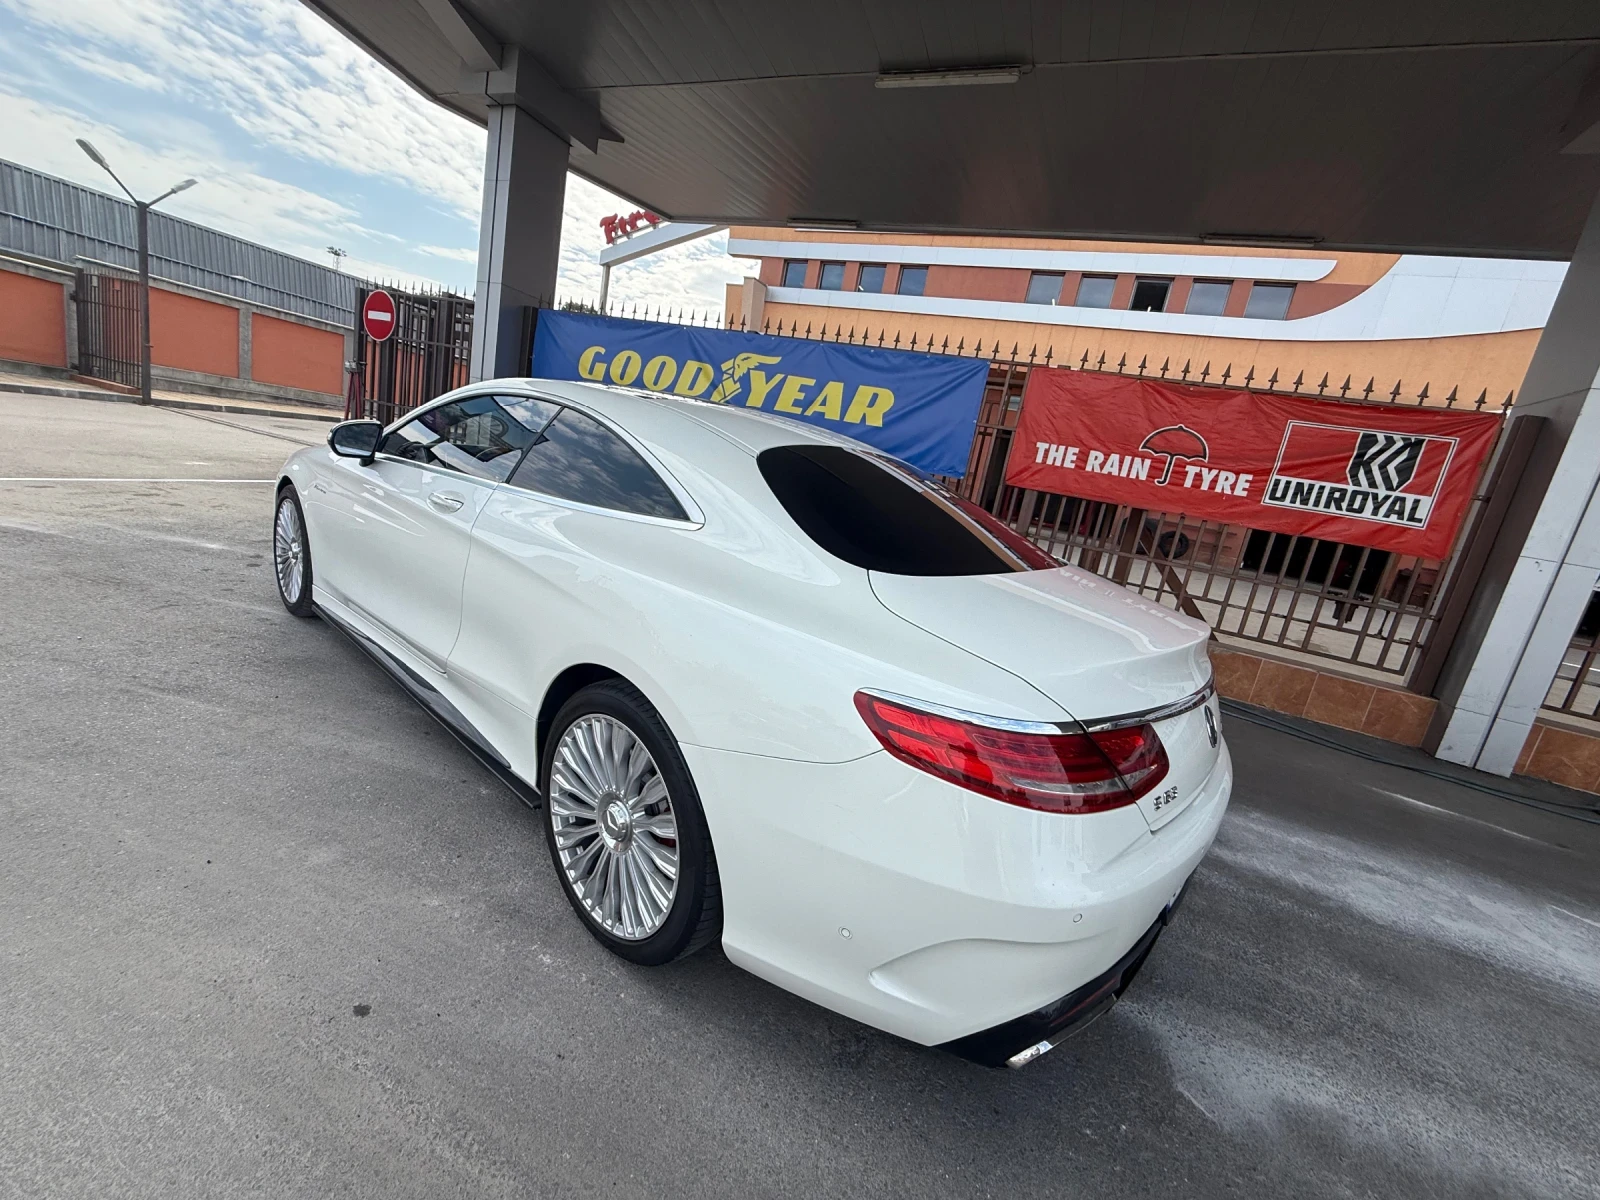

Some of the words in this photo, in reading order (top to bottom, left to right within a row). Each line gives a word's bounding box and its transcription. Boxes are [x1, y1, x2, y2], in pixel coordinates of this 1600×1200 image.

[1035, 441, 1080, 469] THE
[1085, 450, 1152, 481] RAIN
[1183, 464, 1254, 497] TYRE
[1268, 478, 1424, 524] UNIROYAL
